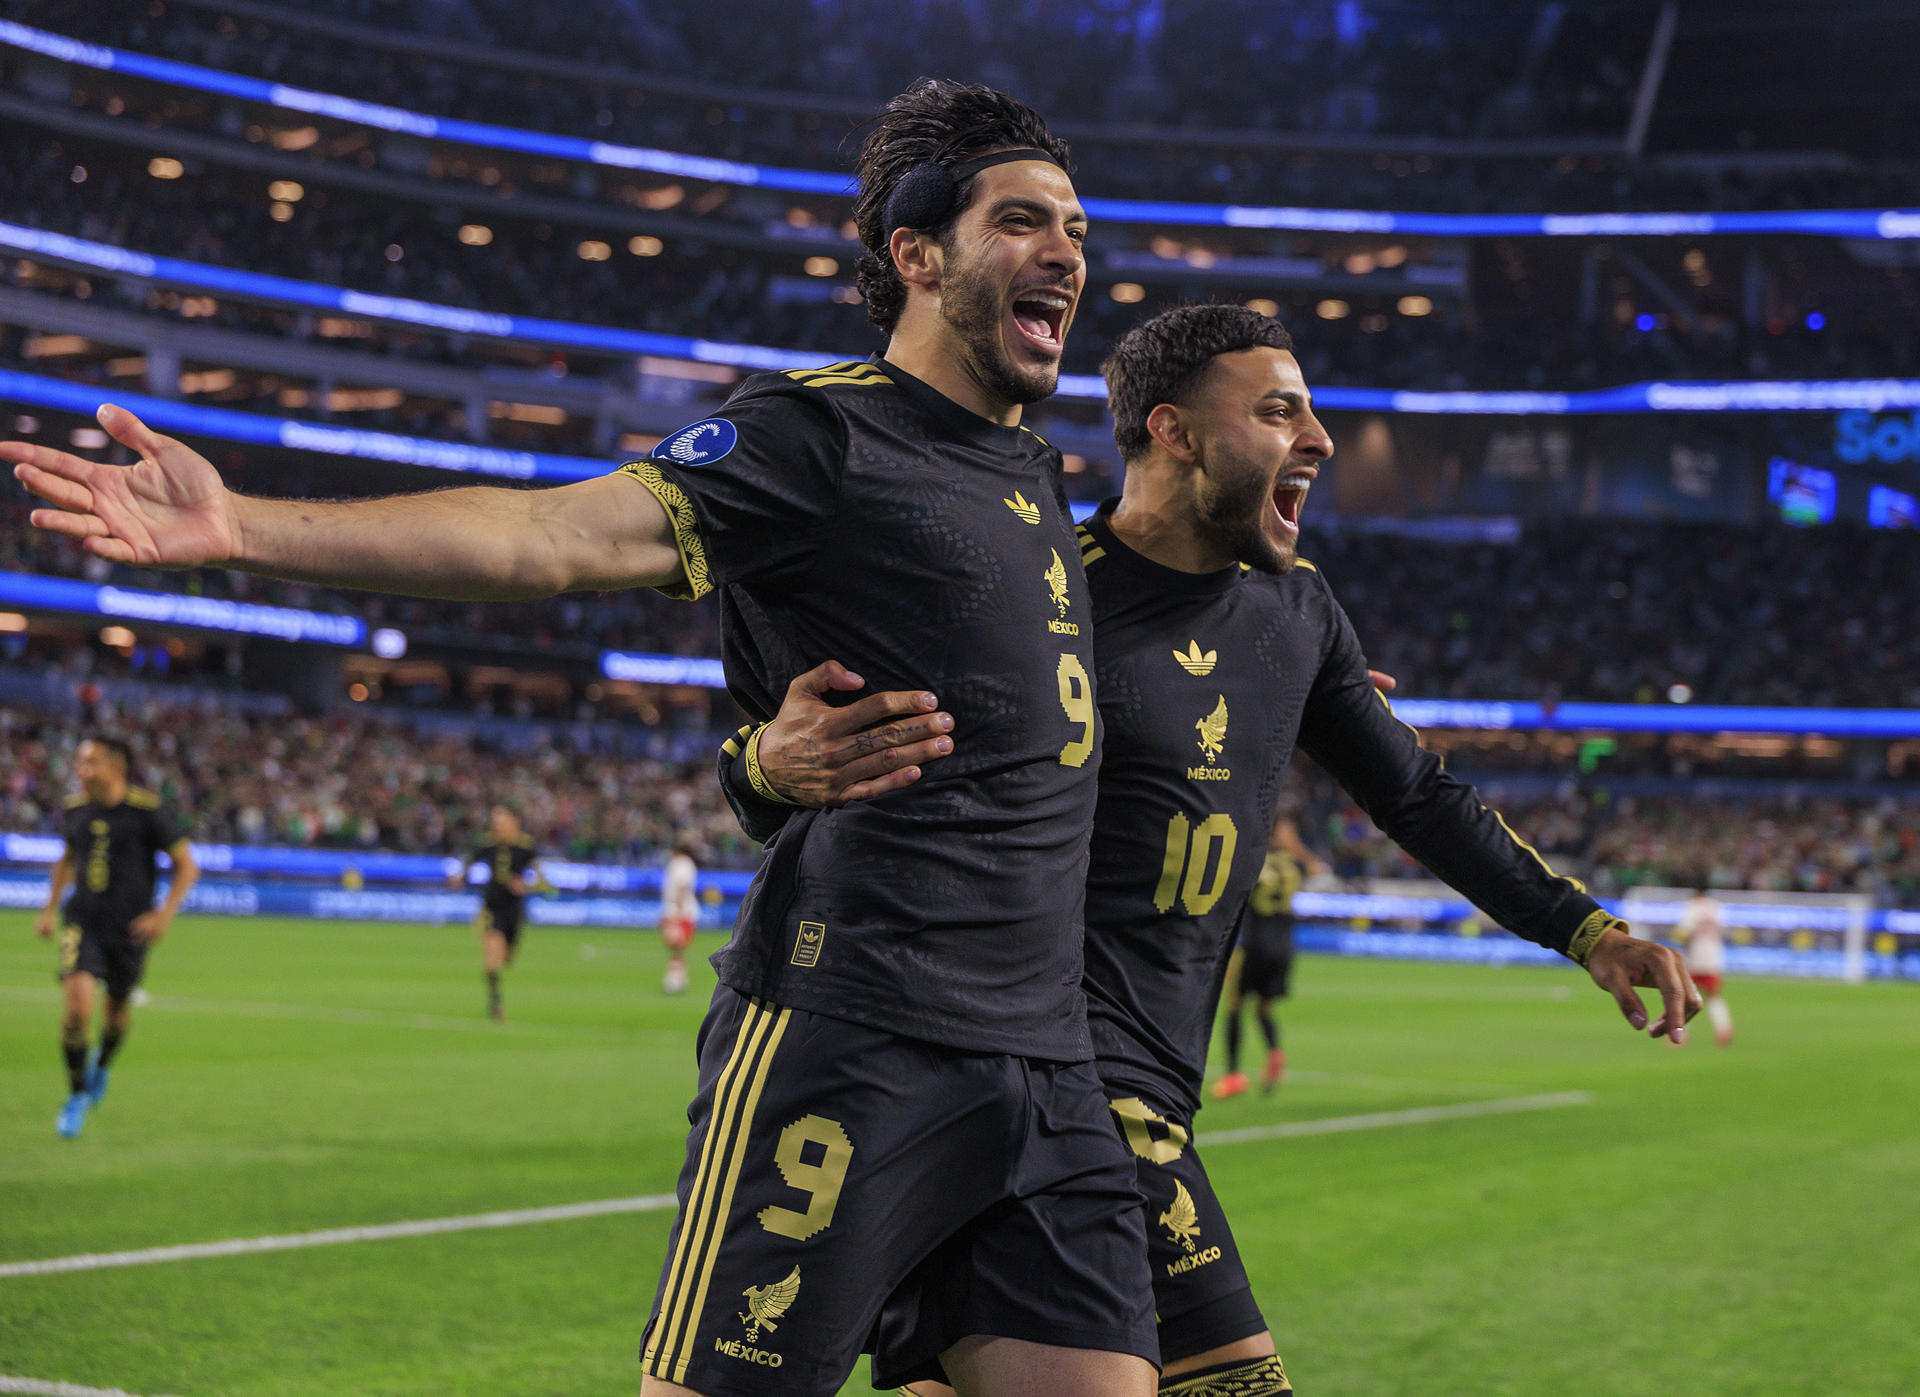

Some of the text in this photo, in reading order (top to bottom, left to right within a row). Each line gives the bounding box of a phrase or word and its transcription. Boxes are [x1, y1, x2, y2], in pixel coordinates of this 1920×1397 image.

[1048, 618, 1080, 636] MÉXICO
[1056, 652, 1095, 768] 9
[1187, 765, 1231, 781] MÉXICO
[1152, 811, 1238, 916] 10
[756, 1113, 855, 1242] 9
[1166, 1245, 1222, 1278] MÉXICO
[714, 1337, 783, 1368] MÉXICO
